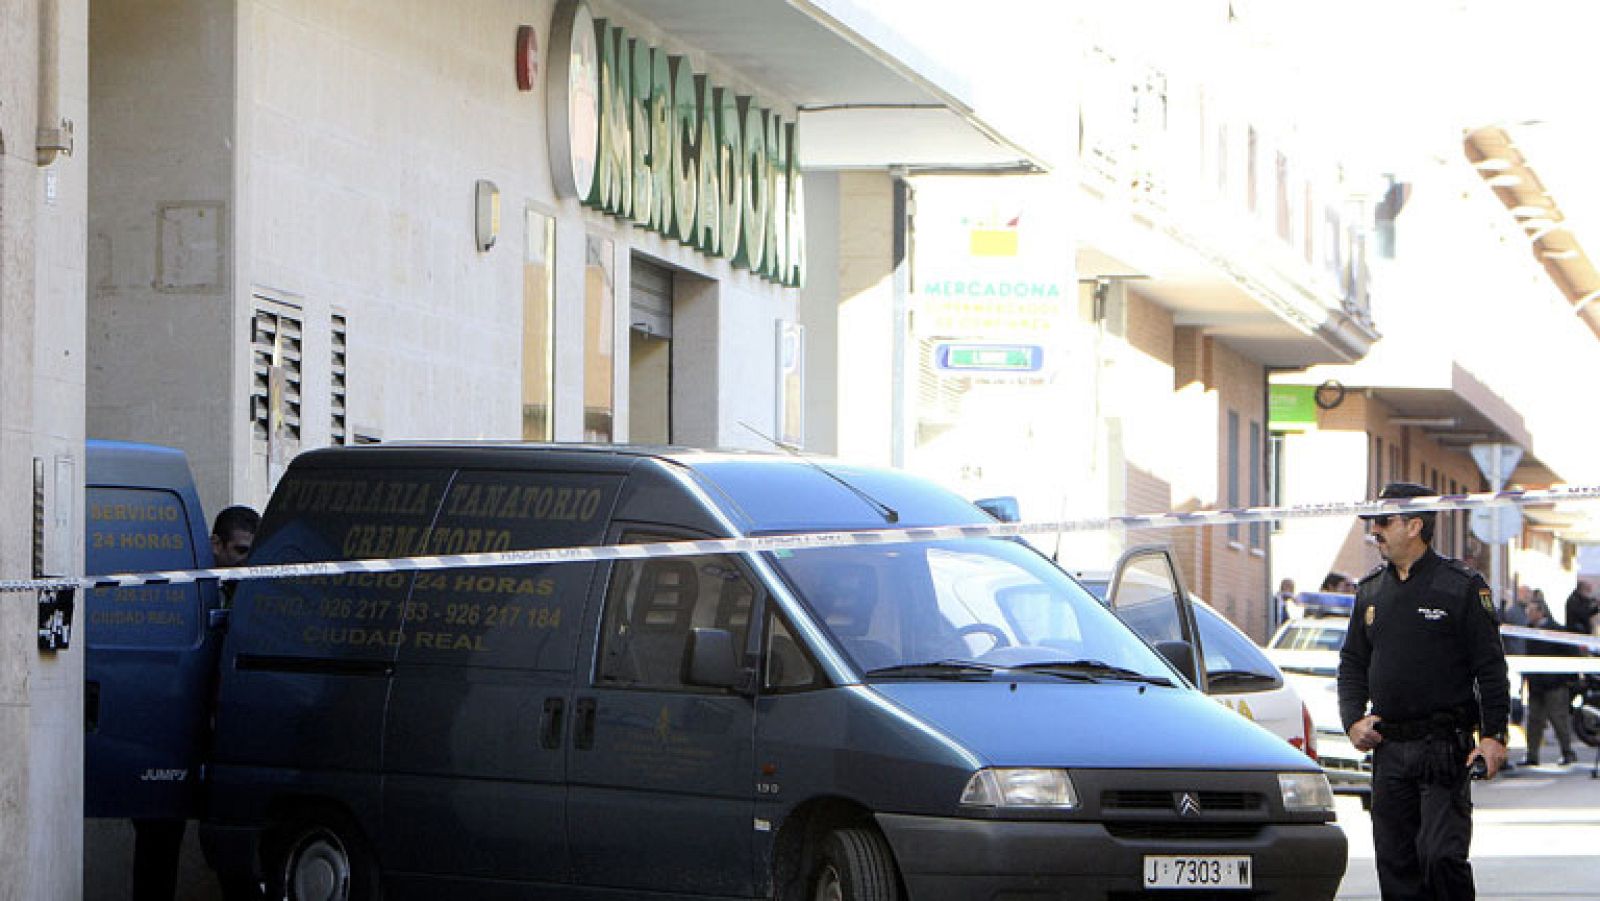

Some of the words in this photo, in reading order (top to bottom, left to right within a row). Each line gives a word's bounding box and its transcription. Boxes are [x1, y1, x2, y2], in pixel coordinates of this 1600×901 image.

[924, 279, 1060, 297] MERCADONA
[279, 480, 432, 513] FUNERARIA
[448, 485, 601, 522] TANATORIO
[92, 503, 178, 521] SERVICIO
[93, 532, 115, 548] 24
[120, 533, 185, 551] HORAS
[343, 526, 511, 558] CREMATORIO
[415, 575, 448, 590] 24
[454, 575, 555, 595] HORAS
[355, 598, 391, 619] 217
[444, 602, 481, 624] 926
[485, 605, 520, 626] 217
[527, 606, 561, 628] 184
[303, 626, 408, 646] CIUDAD
[415, 631, 490, 652] REAL
[140, 768, 188, 781] JUMPY
